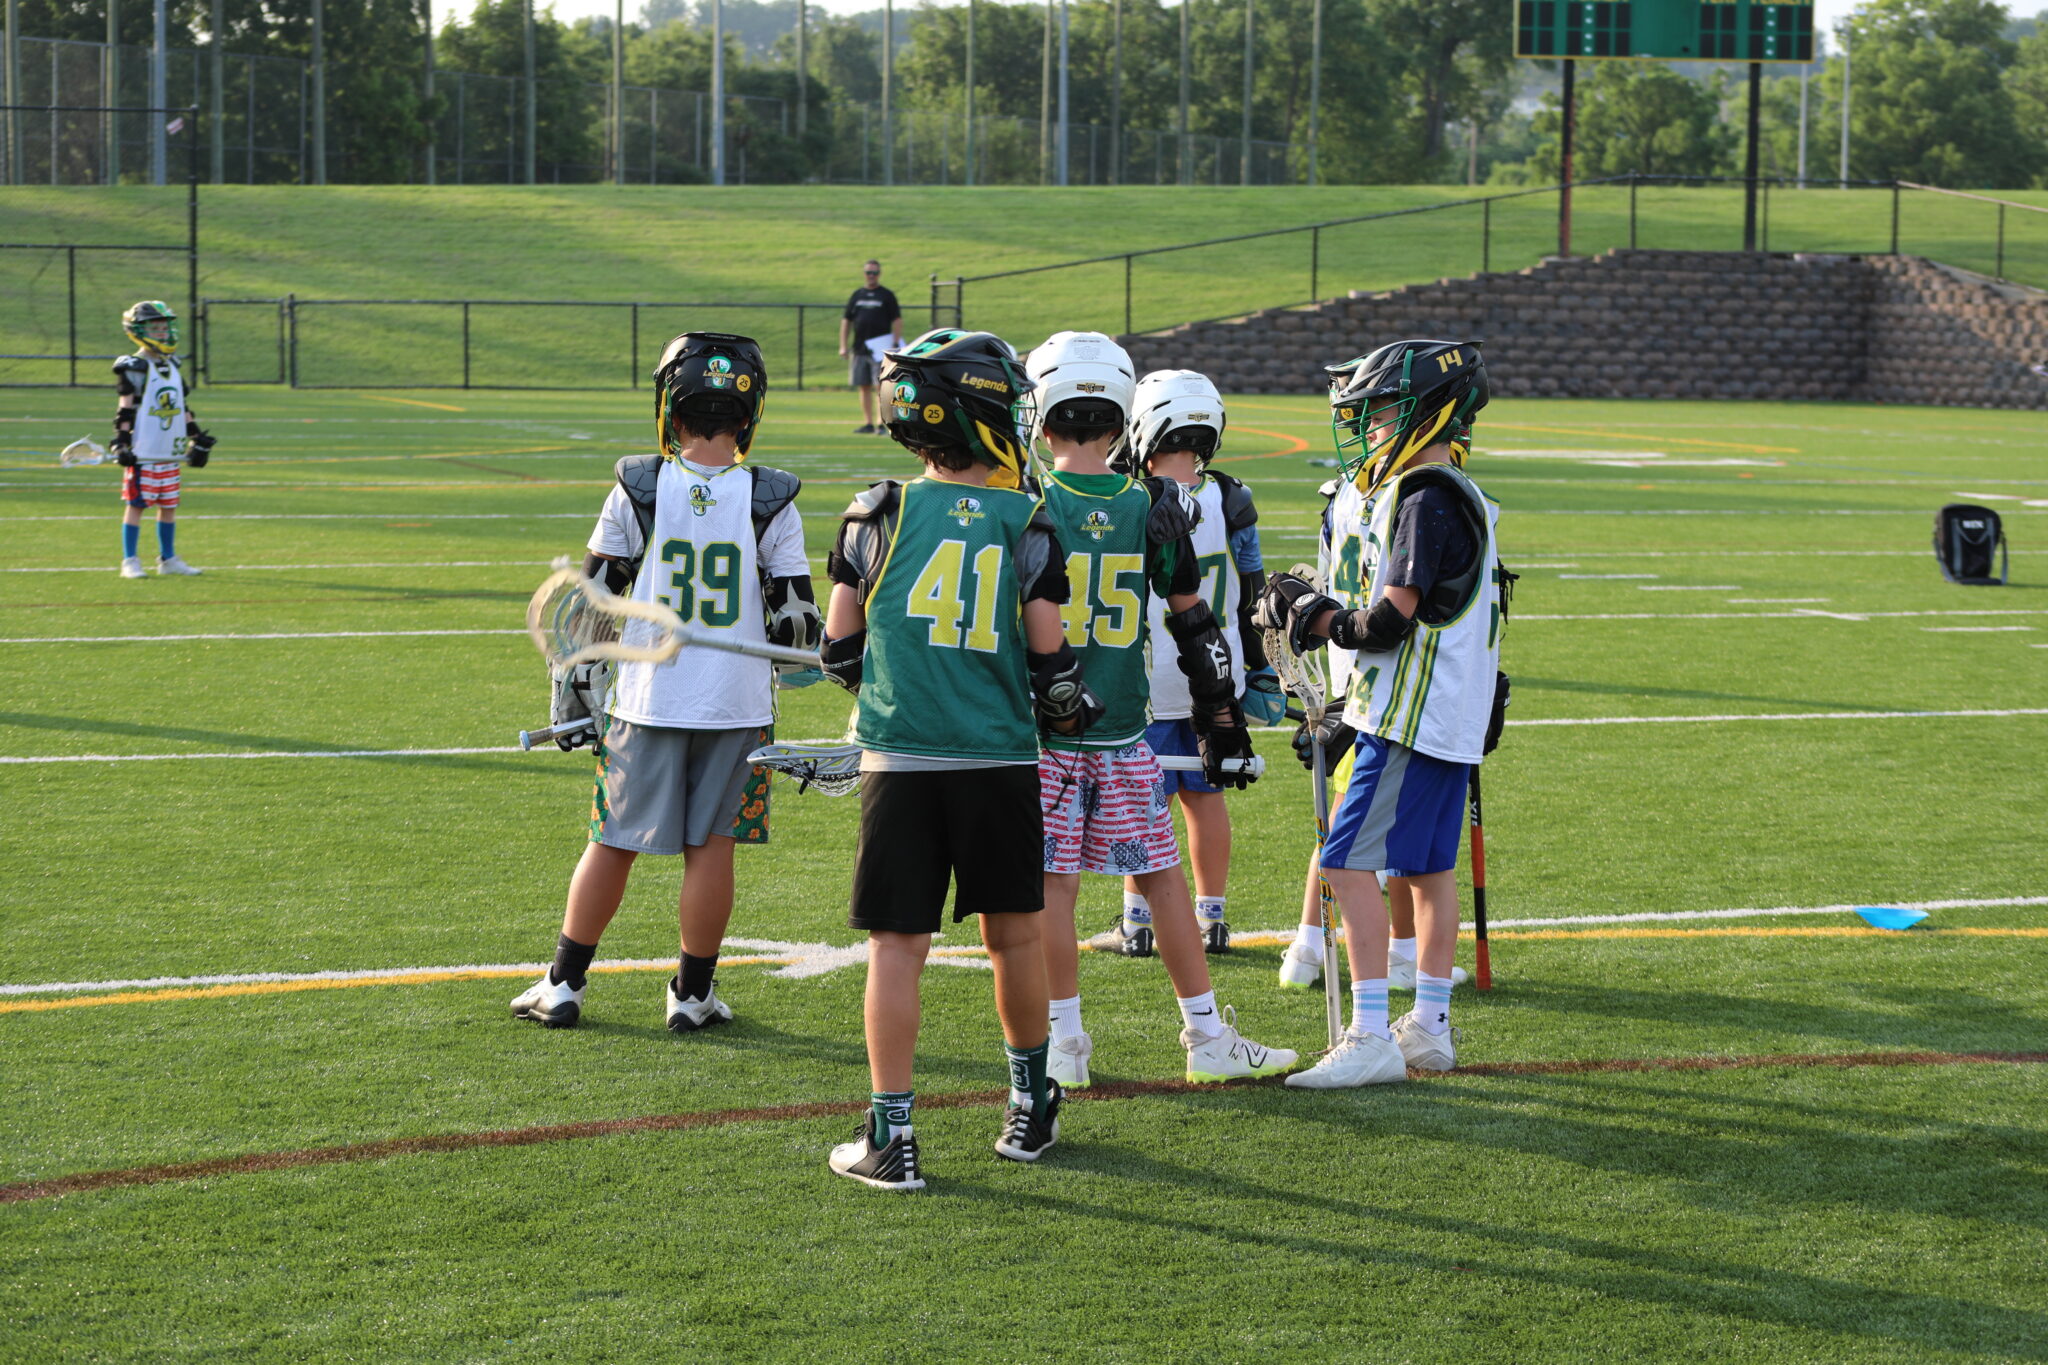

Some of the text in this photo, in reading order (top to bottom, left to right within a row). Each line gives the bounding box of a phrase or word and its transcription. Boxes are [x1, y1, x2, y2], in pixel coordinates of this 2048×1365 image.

[1436, 349, 1463, 373] 14
[961, 372, 1008, 393] Legends
[891, 399, 920, 410] Legends
[928, 409, 940, 418] 25
[948, 508, 986, 519] Legends
[1081, 524, 1115, 533] Legends
[656, 537, 742, 629] 39
[907, 539, 1003, 653] 41
[1060, 552, 1144, 648] 45
[1205, 638, 1229, 680] STX
